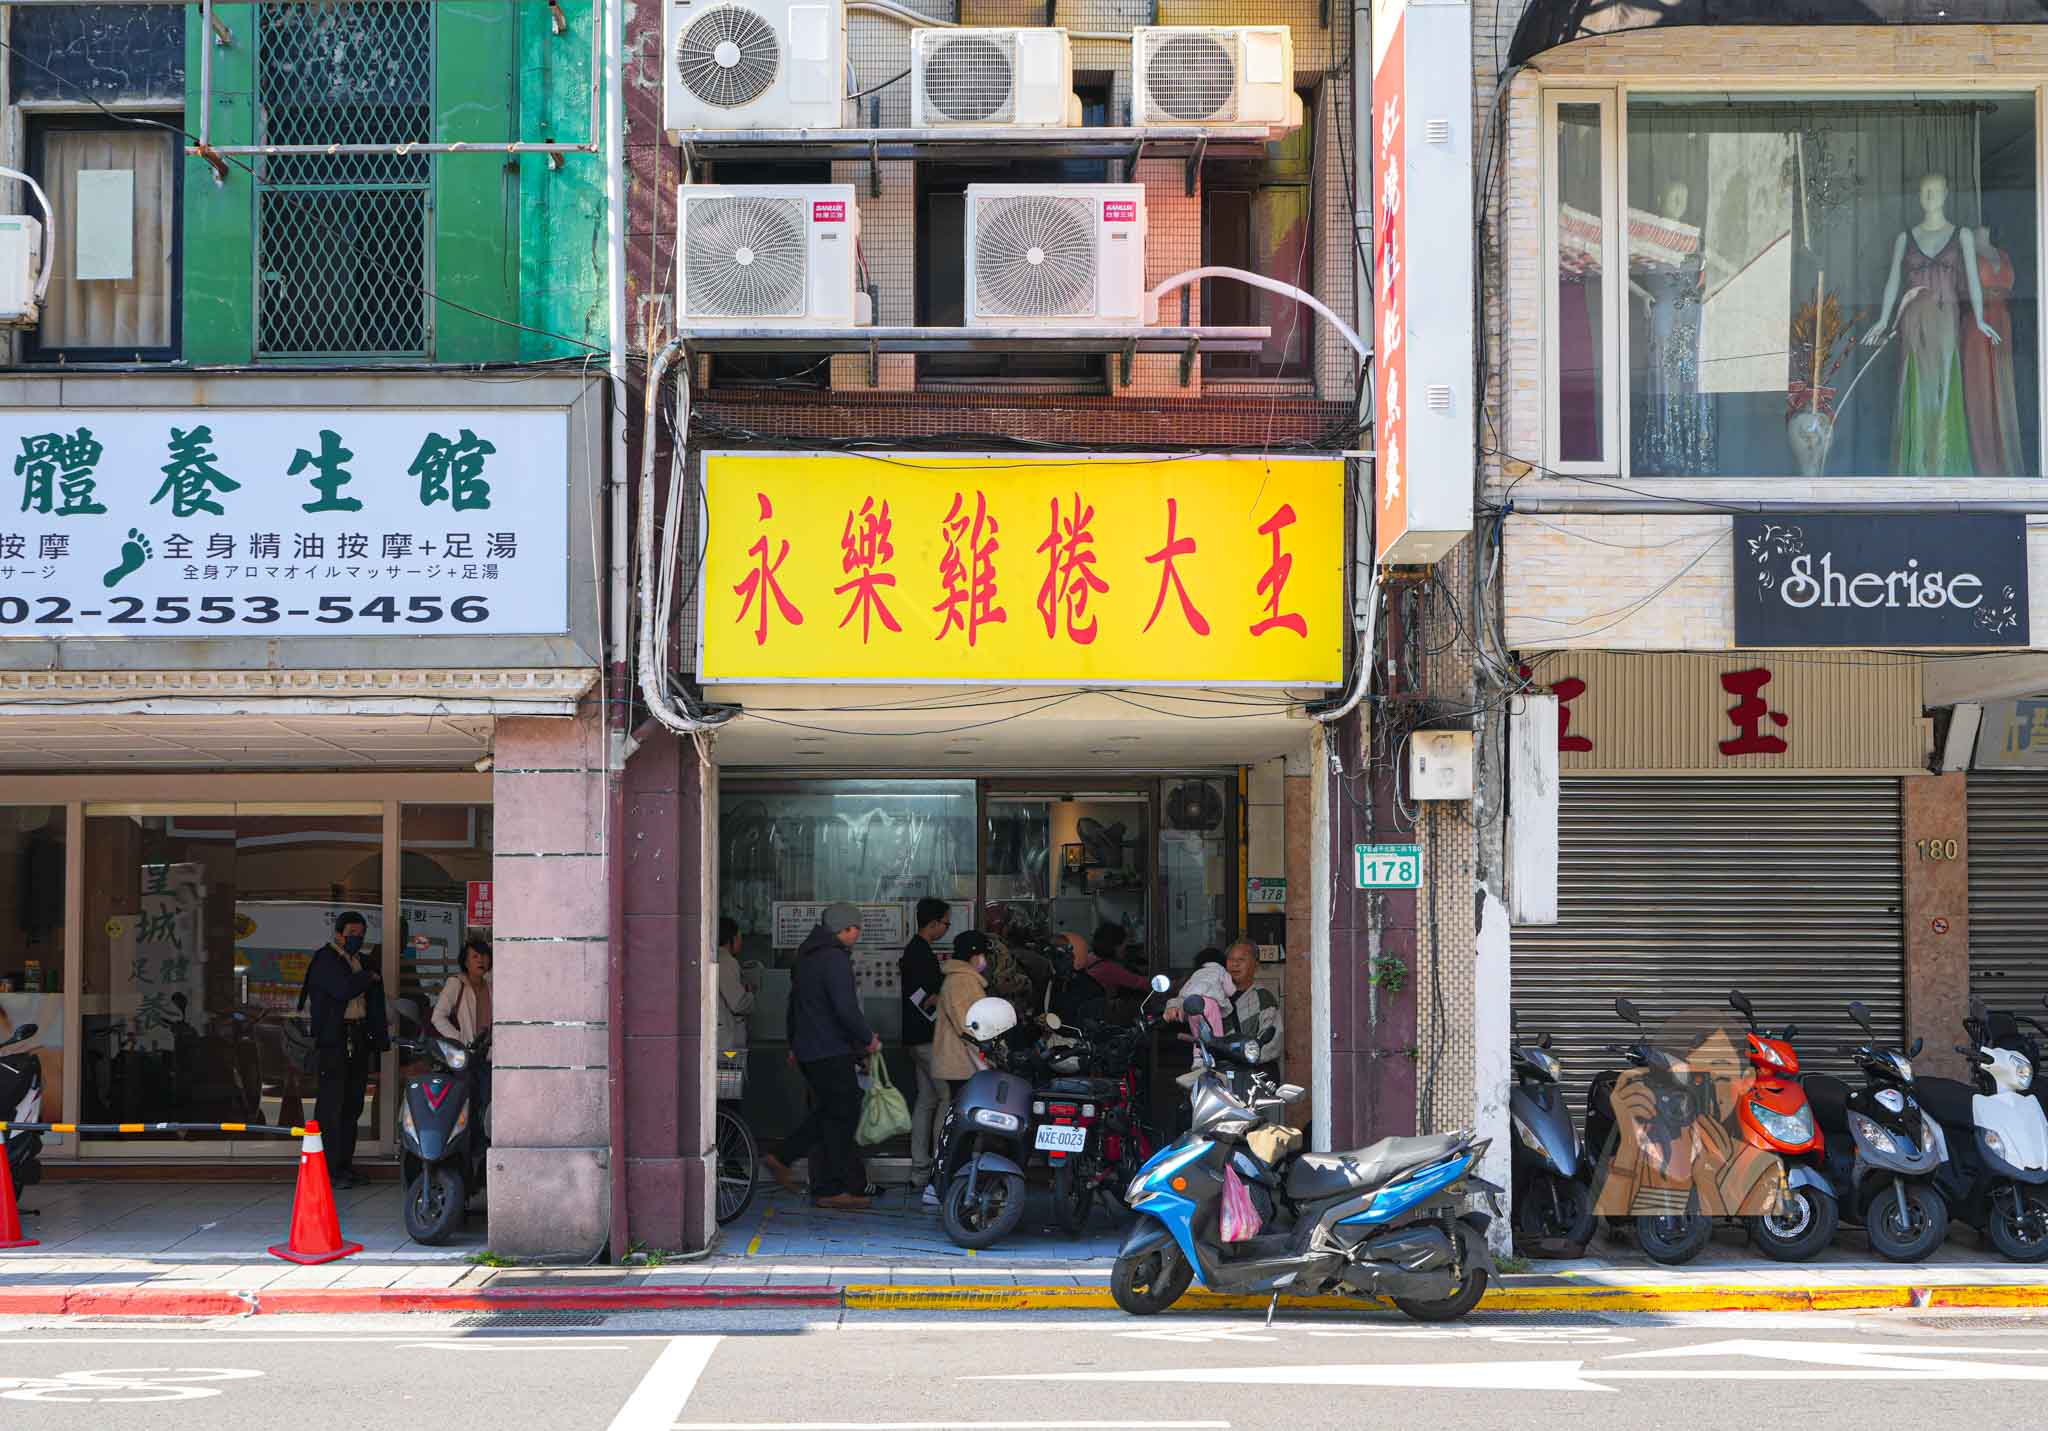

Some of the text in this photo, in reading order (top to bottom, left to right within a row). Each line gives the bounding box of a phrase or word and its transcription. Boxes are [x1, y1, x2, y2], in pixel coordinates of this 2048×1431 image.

[14, 424, 497, 518] 體養生館
[163, 531, 518, 560] 全身精油按摩+足湯
[733, 489, 1307, 648] 永樂雞捲大王
[1781, 552, 1983, 608] Sherise
[0, 595, 490, 624] 02-2553-5456
[1916, 839, 1958, 861] 180
[1367, 861, 1412, 881] 178
[1262, 888, 1283, 900] 178
[1037, 1130, 1084, 1147] NXE-0023
